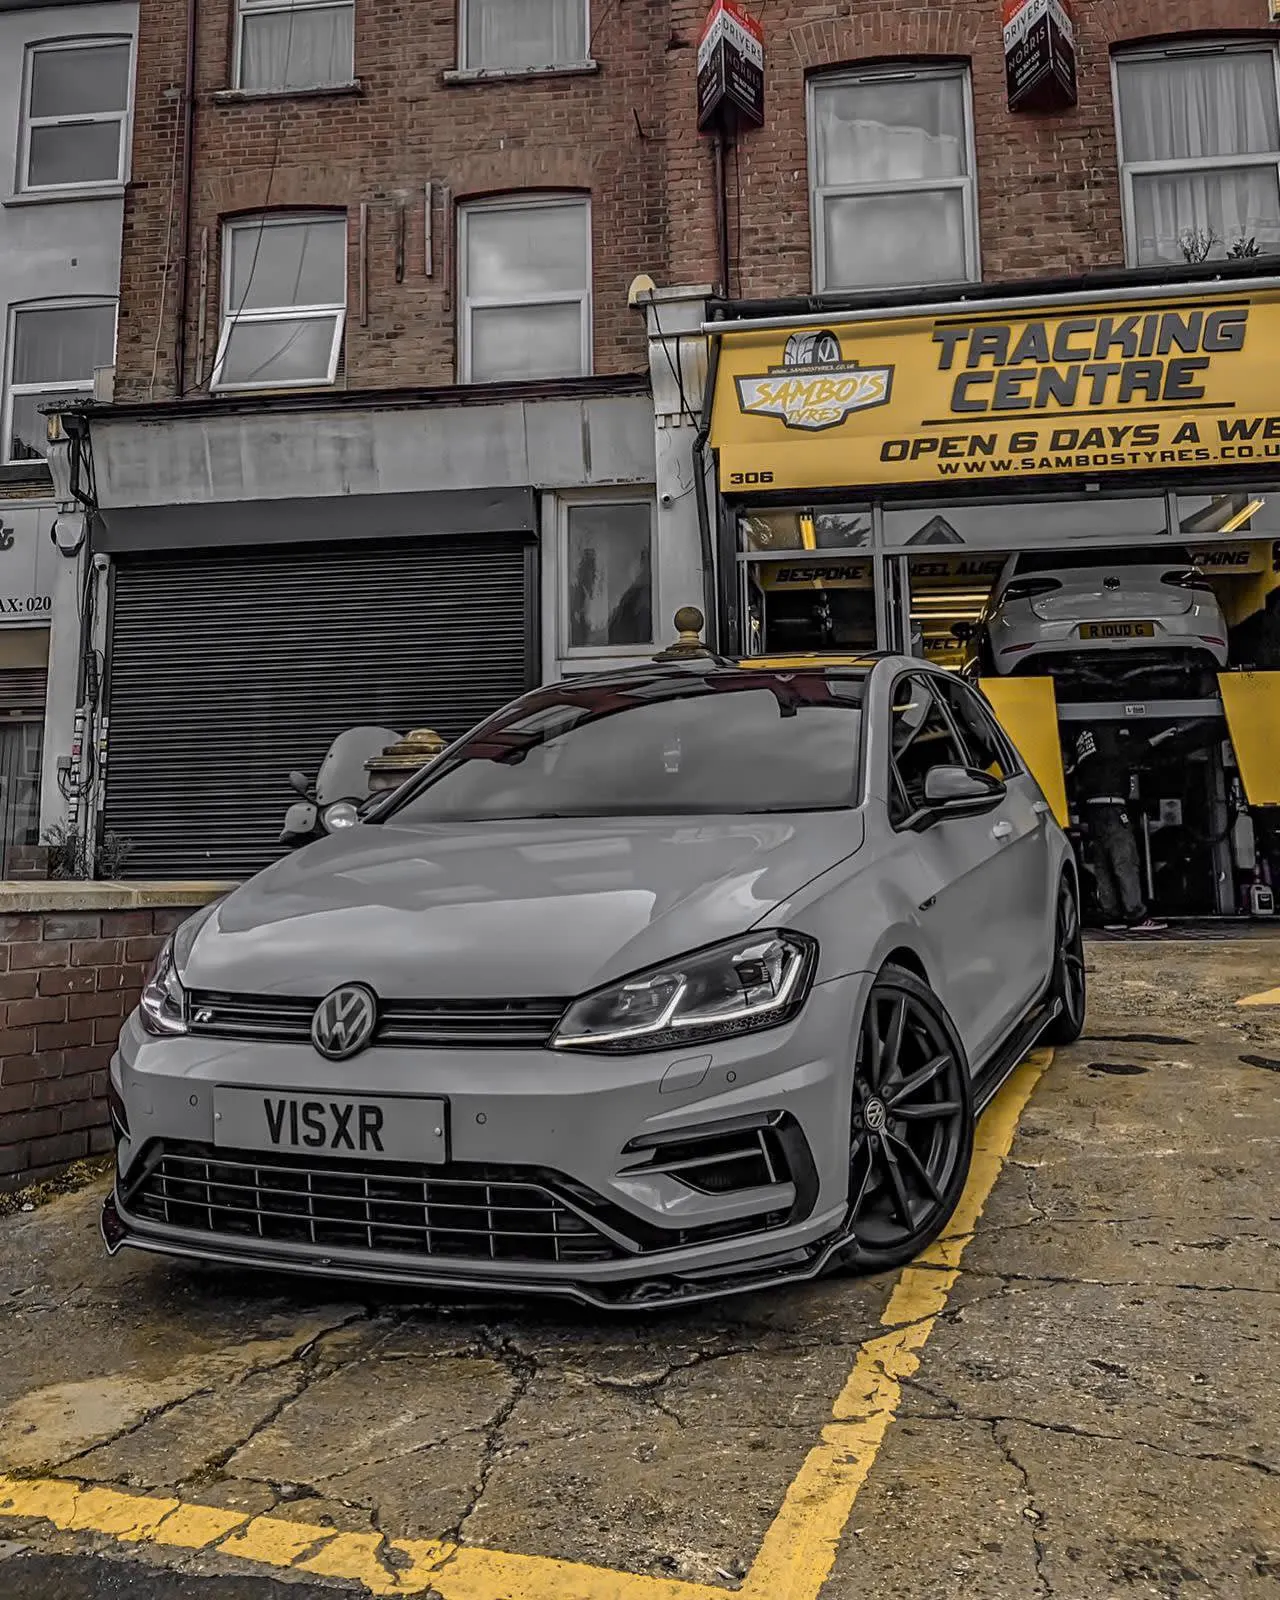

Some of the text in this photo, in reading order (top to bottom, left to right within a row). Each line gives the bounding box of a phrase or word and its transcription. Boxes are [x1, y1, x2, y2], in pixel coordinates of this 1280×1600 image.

[723, 17, 762, 62] DRIVERS
[1009, 26, 1045, 72] NORRIS
[931, 309, 1250, 371] TRACKING
[744, 373, 885, 411] SAMBO'S
[950, 356, 1211, 413] CENTRE
[787, 406, 843, 425] TYRES
[879, 433, 998, 463] OPEN
[1008, 431, 1039, 454] 6
[1048, 423, 1160, 452] DAYS
[1171, 422, 1201, 445] A
[730, 471, 775, 485] 306
[775, 566, 865, 583] BESPOKE
[26, 596, 52, 612] 020
